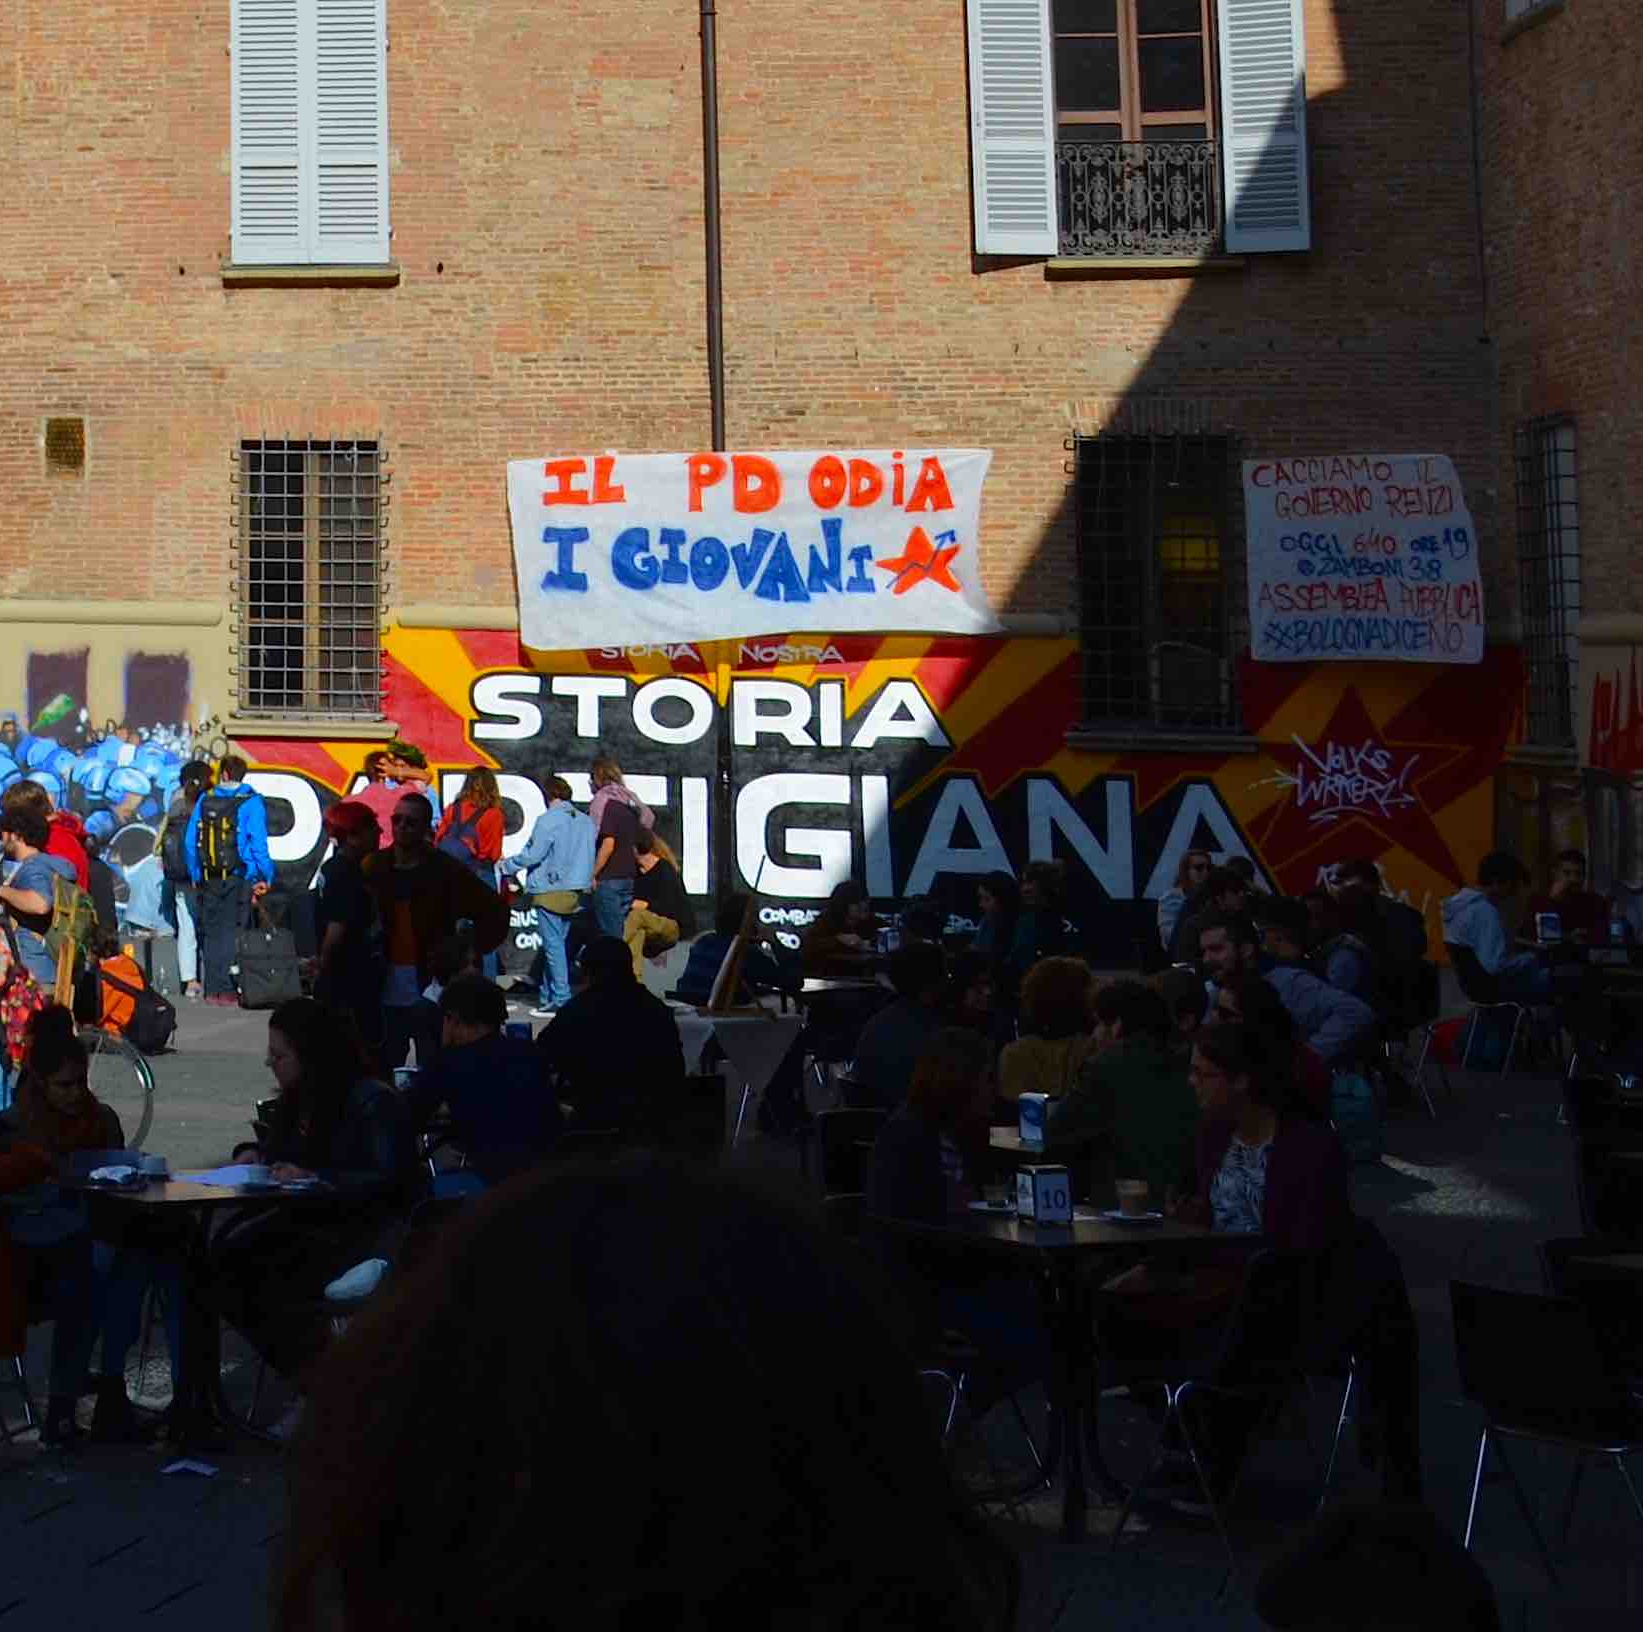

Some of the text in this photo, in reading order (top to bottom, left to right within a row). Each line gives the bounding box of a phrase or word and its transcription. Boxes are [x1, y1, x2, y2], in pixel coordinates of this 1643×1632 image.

[542, 455, 626, 506] IL
[686, 453, 782, 514] PD
[1250, 457, 1440, 487] CACCIAMO IL
[1274, 485, 1454, 519] GOVERNO RENZI
[1279, 532, 1344, 555] OGGI
[540, 518, 877, 603] I GIOVANI
[1408, 555, 1443, 582] 38
[601, 640, 845, 665] STORIA NOSTRA
[472, 672, 954, 748] STORIA
[241, 767, 1278, 900] PRIGIANA
[1044, 1190, 1066, 1209] 10
